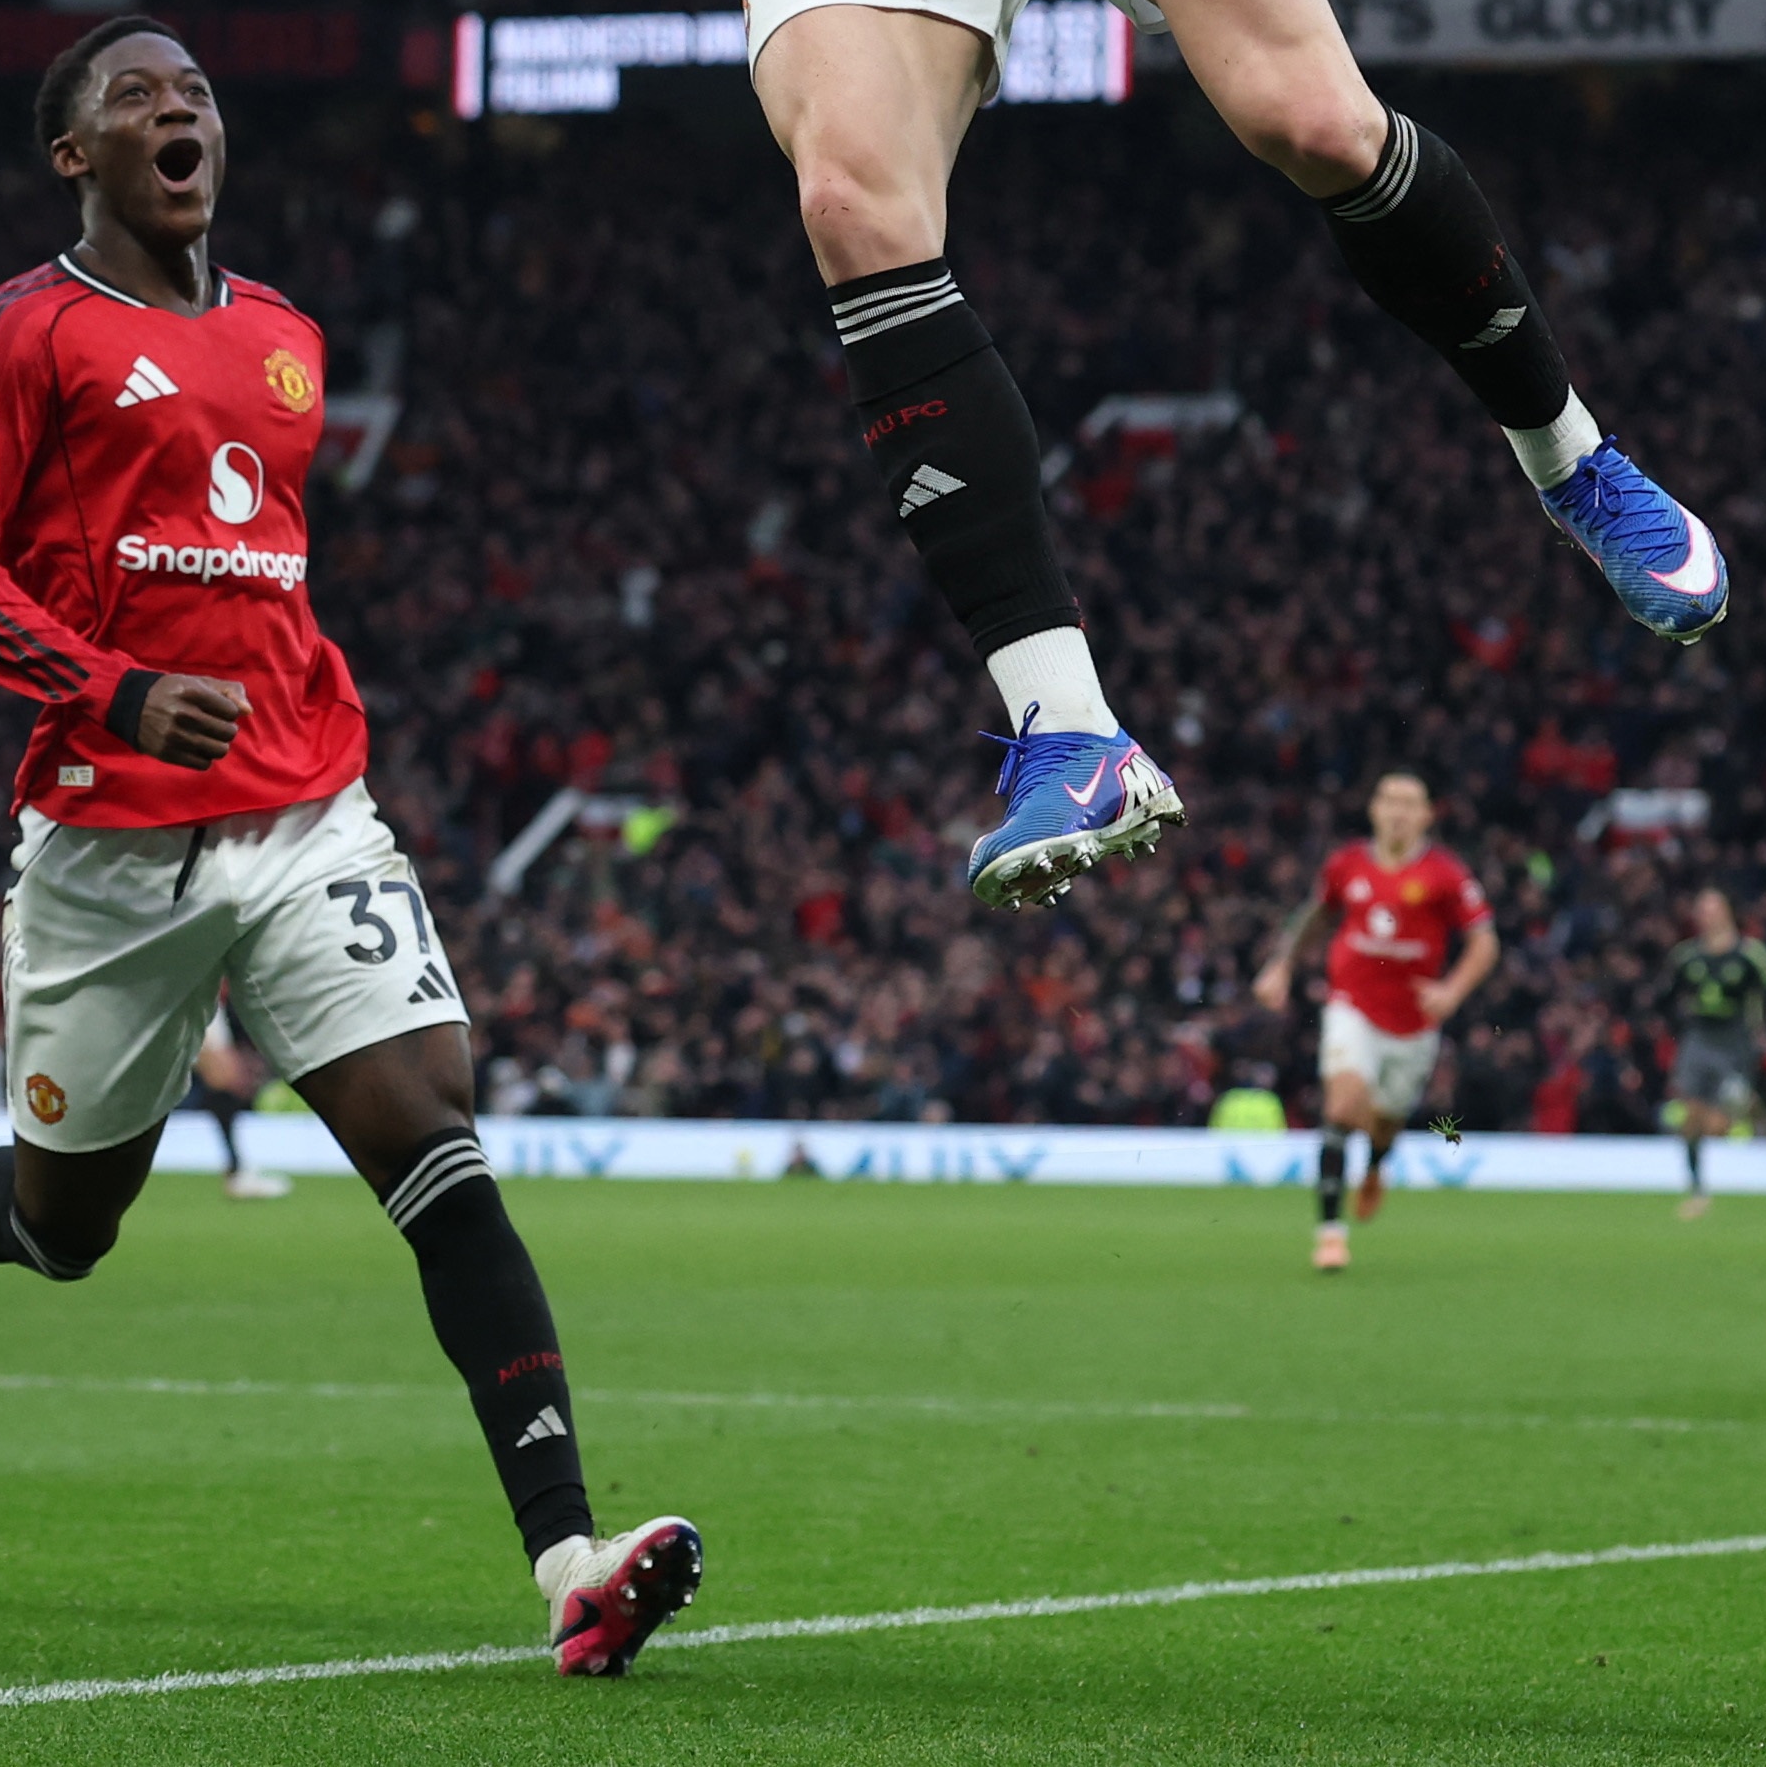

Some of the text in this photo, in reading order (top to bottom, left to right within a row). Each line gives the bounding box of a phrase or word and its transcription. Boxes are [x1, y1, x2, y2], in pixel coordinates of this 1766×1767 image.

[863, 400, 948, 449] MUFC
[117, 534, 307, 591] Snapdrago
[327, 880, 431, 965] 37
[498, 1352, 564, 1385] MUFC
